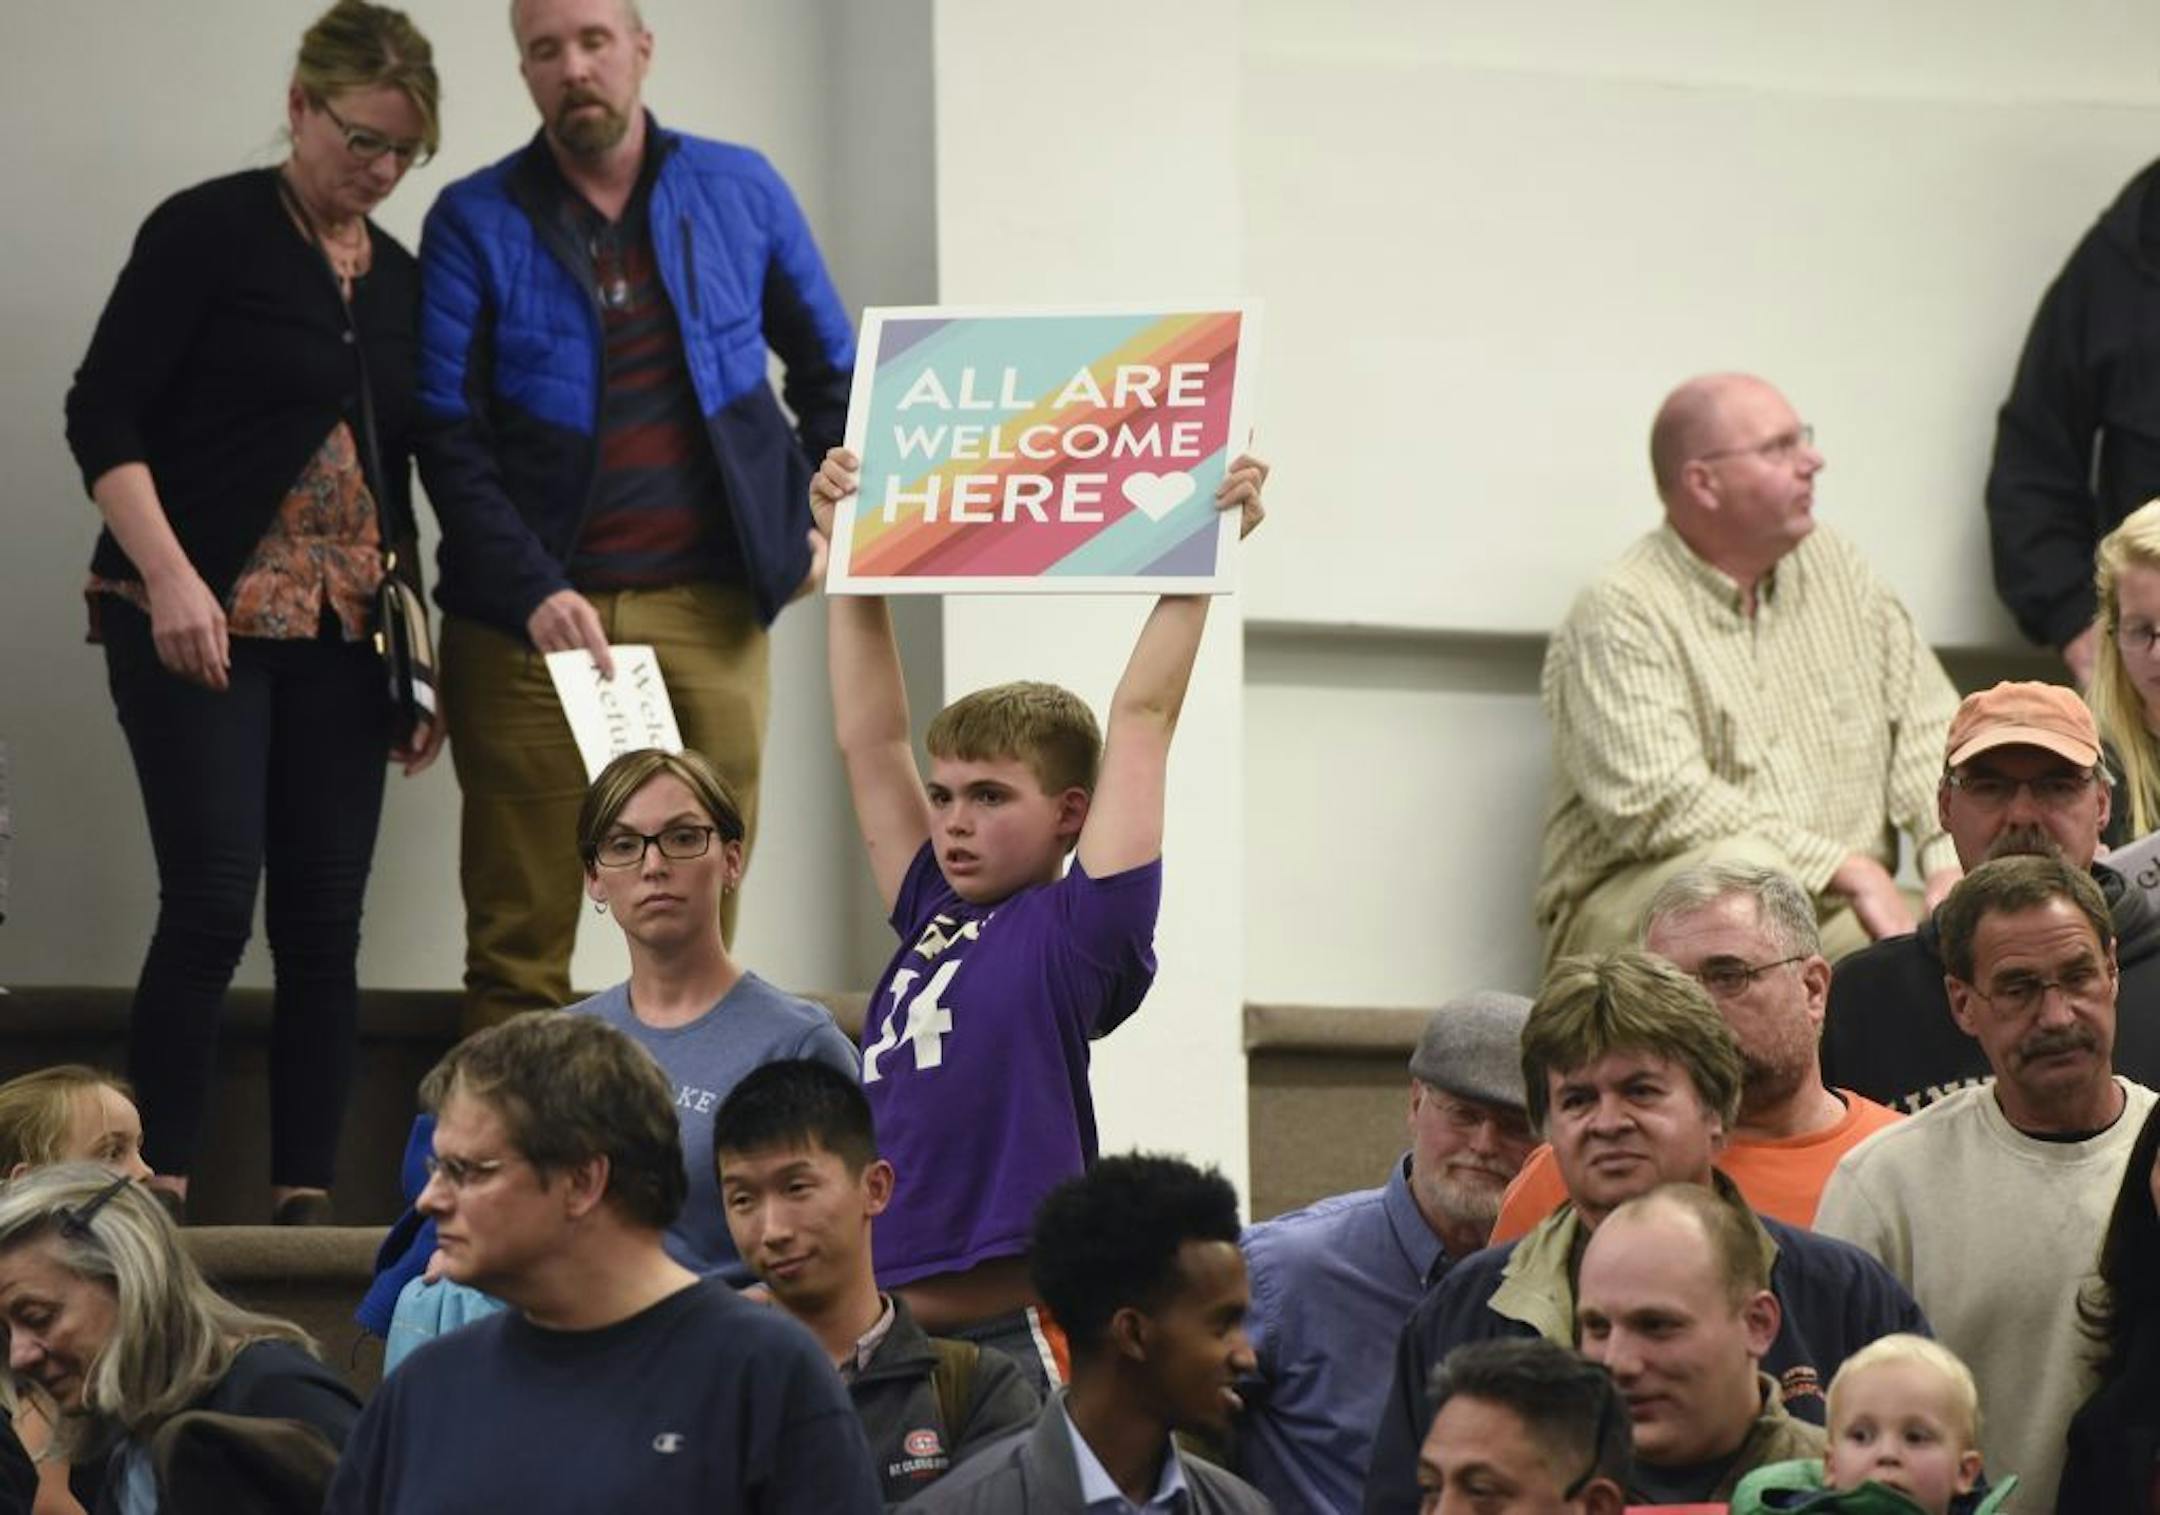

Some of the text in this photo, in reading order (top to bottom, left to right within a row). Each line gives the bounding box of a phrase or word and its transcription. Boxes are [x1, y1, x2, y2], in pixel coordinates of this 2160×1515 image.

[896, 362, 1210, 411] ALL ARE
[893, 421, 1203, 460] WELCOME
[882, 472, 1109, 524] HERE
[862, 959, 963, 1084] 14
